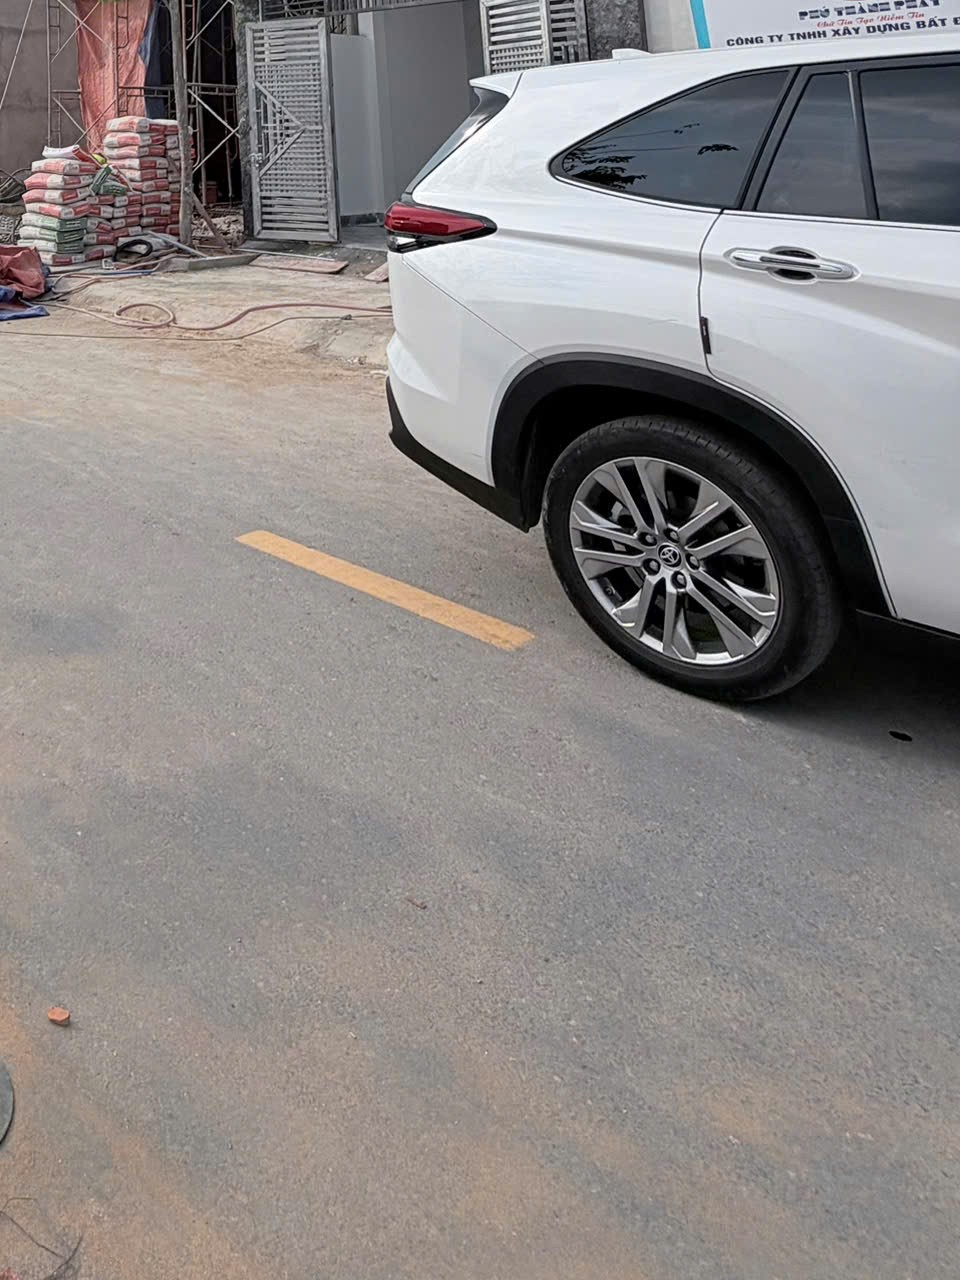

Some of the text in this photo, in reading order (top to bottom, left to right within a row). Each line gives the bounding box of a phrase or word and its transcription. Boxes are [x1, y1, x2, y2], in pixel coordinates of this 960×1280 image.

[834, 2, 891, 16] THÀNH
[726, 36, 764, 46] CÔNG
[767, 34, 783, 43] TY
[787, 30, 827, 41] TNHH
[831, 26, 861, 37] XÂY
[866, 21, 911, 34] DỰNG
[916, 16, 948, 29] BẤT
